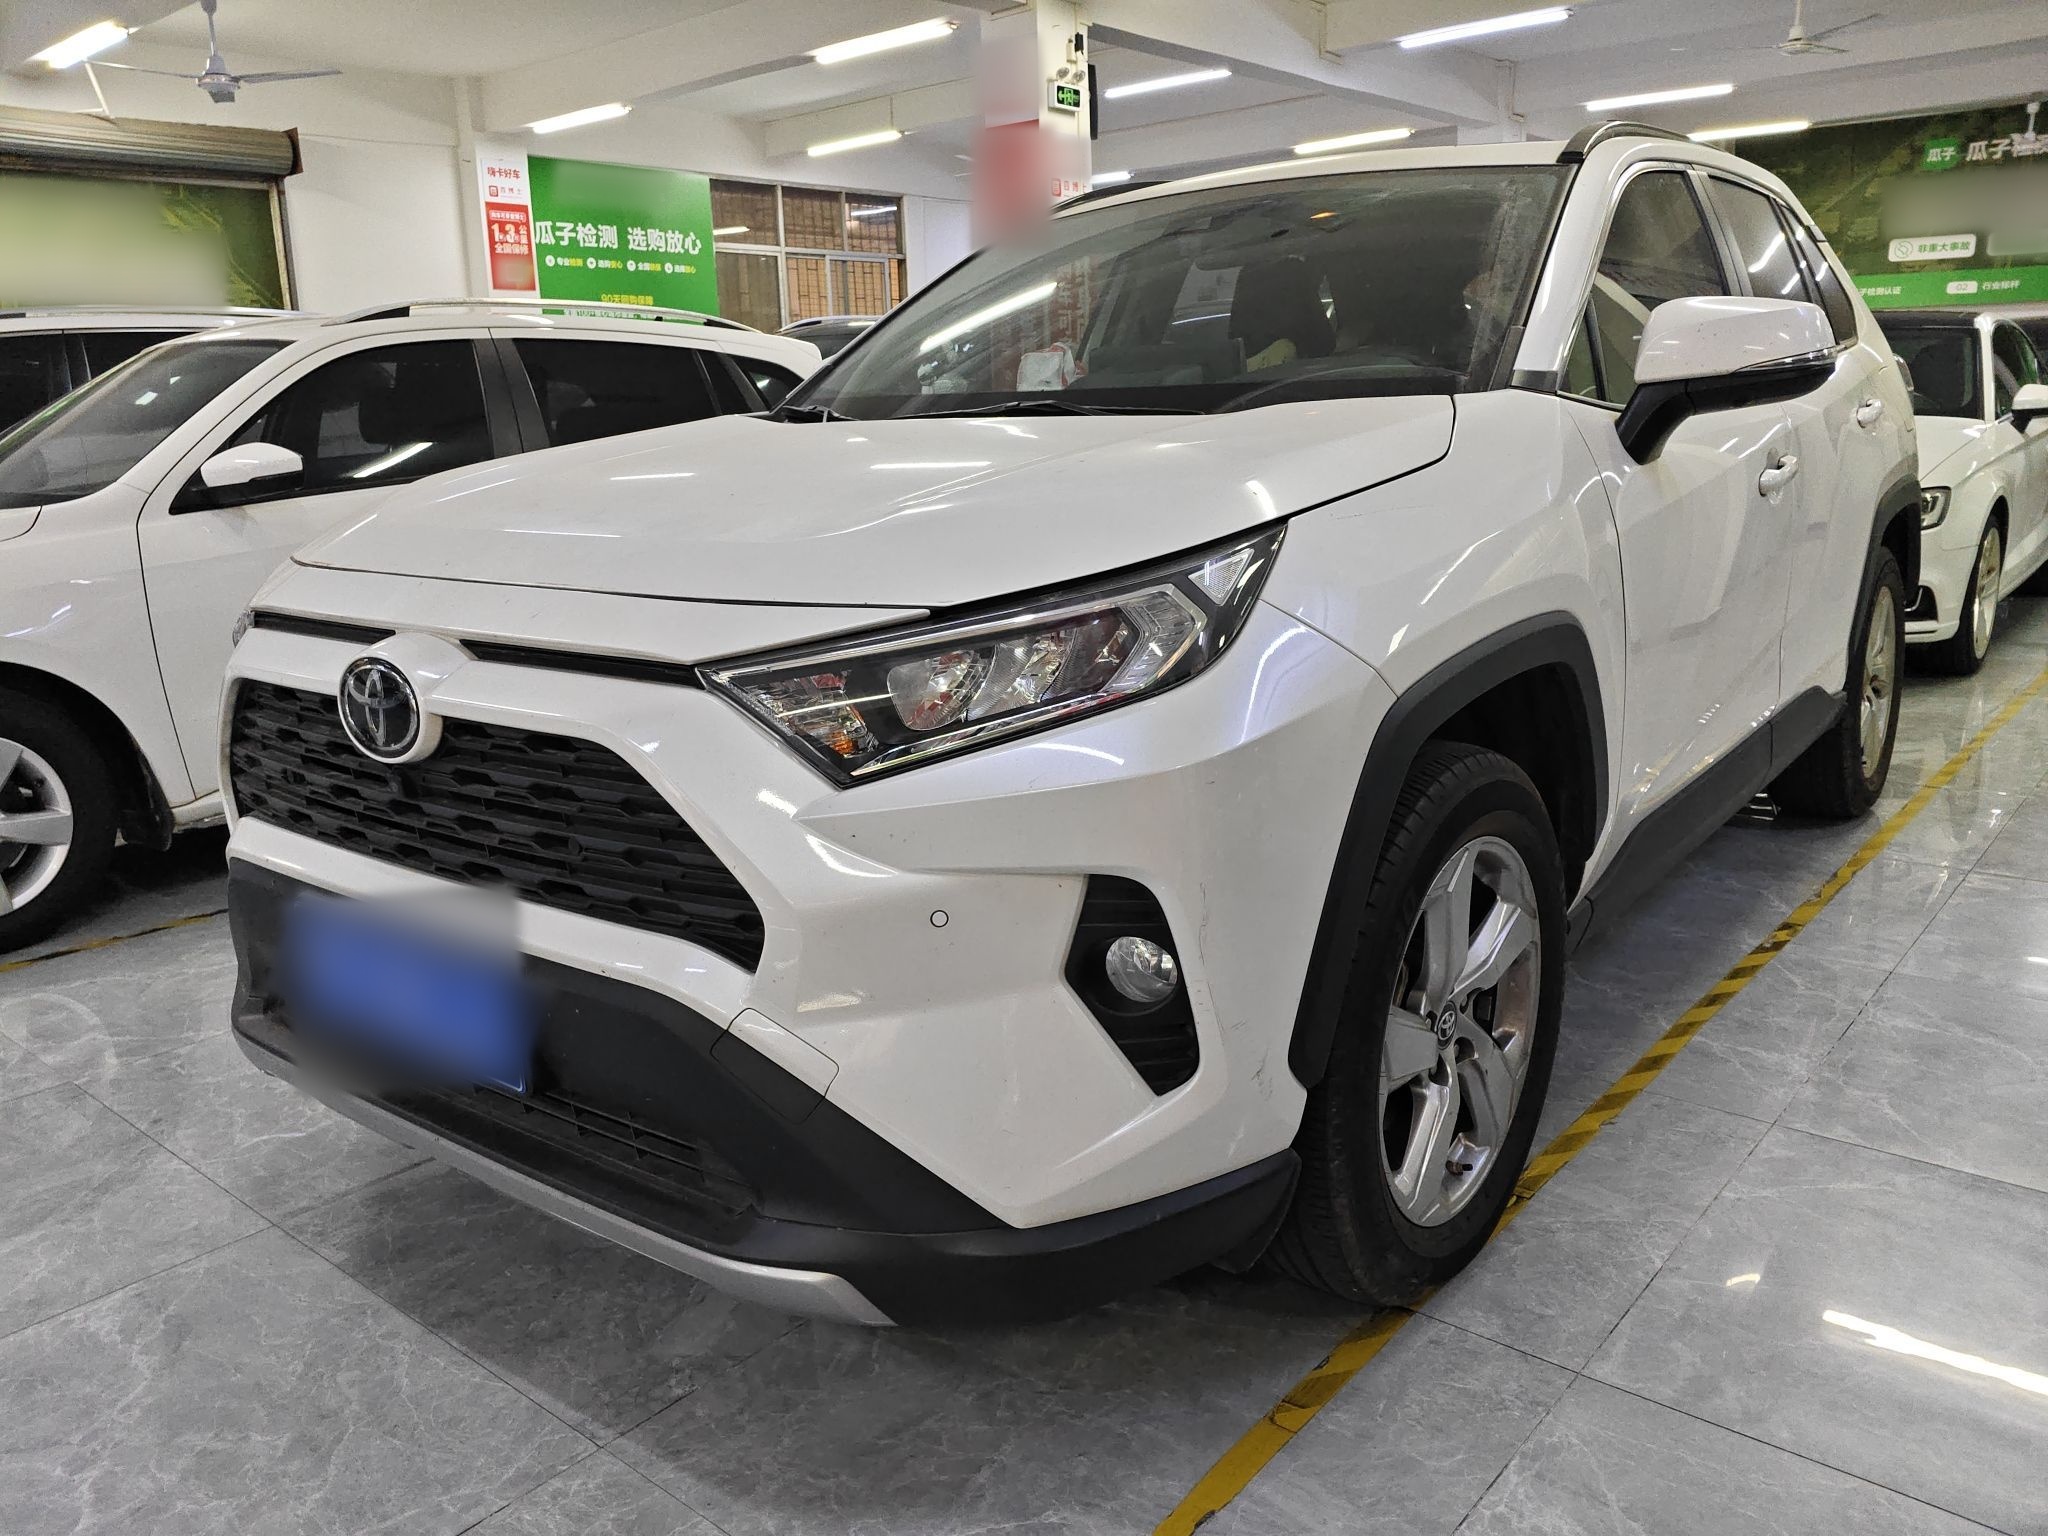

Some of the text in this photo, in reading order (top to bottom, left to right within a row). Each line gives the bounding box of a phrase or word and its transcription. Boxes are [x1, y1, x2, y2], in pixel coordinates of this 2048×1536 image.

[535, 221, 702, 255] 瓜子检测 选购放心
[1918, 241, 1970, 253] 非重大事故
